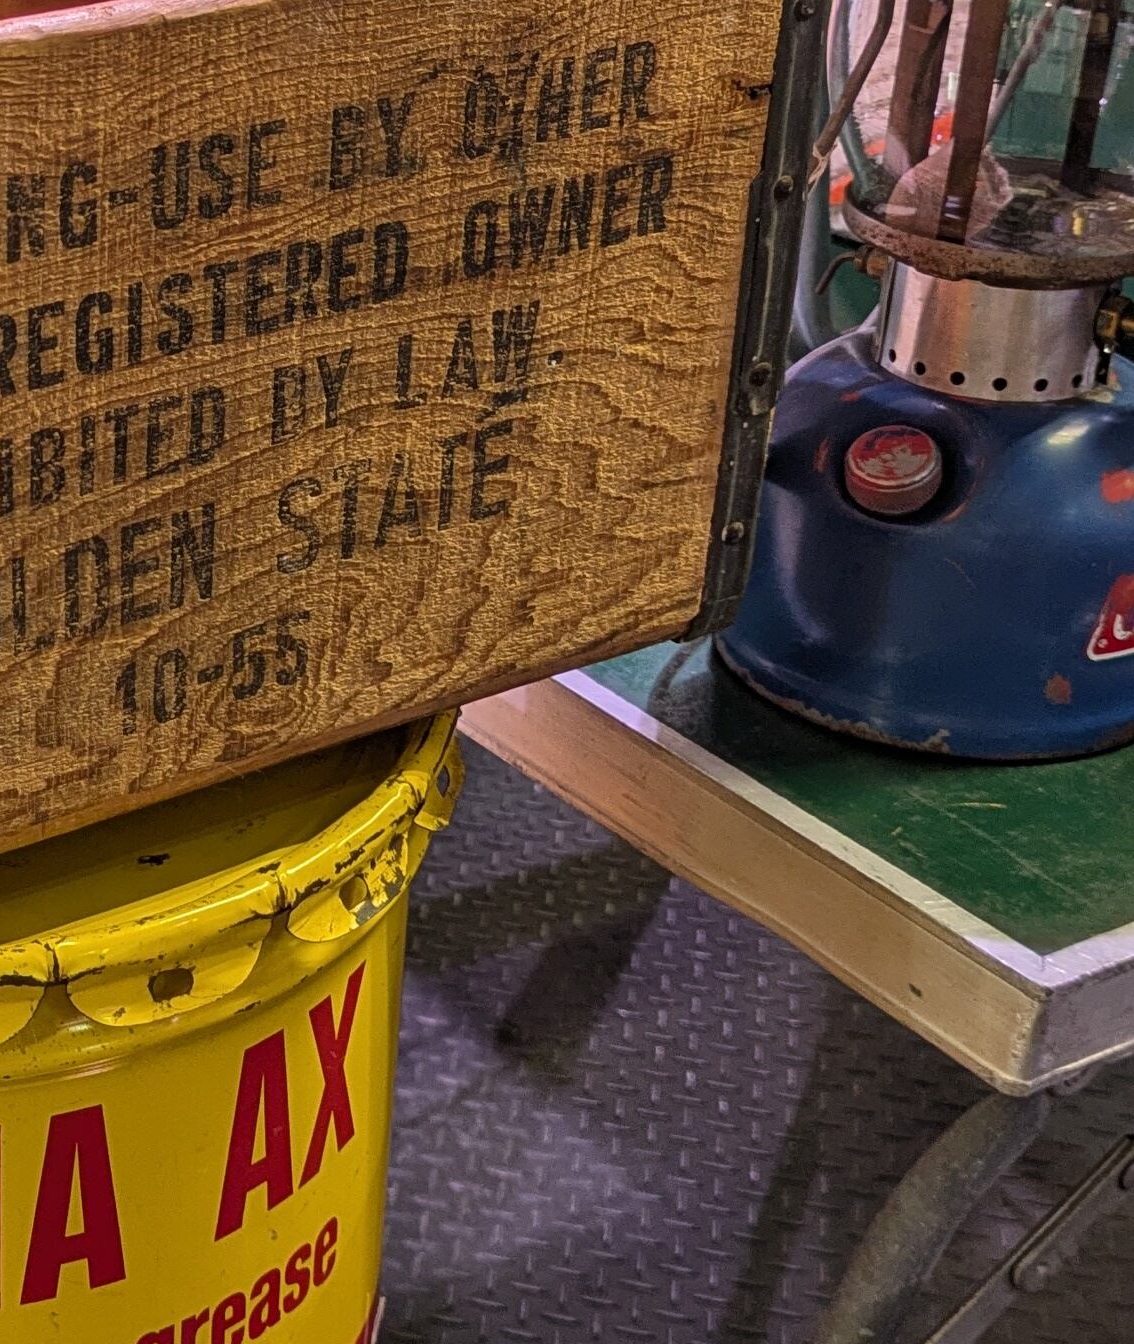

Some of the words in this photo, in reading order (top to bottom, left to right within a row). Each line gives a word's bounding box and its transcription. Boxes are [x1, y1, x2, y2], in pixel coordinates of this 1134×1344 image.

[326, 90, 418, 193] BY
[462, 40, 659, 168] OTHER
[463, 152, 674, 280] OWNER
[271, 347, 354, 448] BY
[274, 416, 514, 575] STATE
[213, 959, 369, 1243] AX
